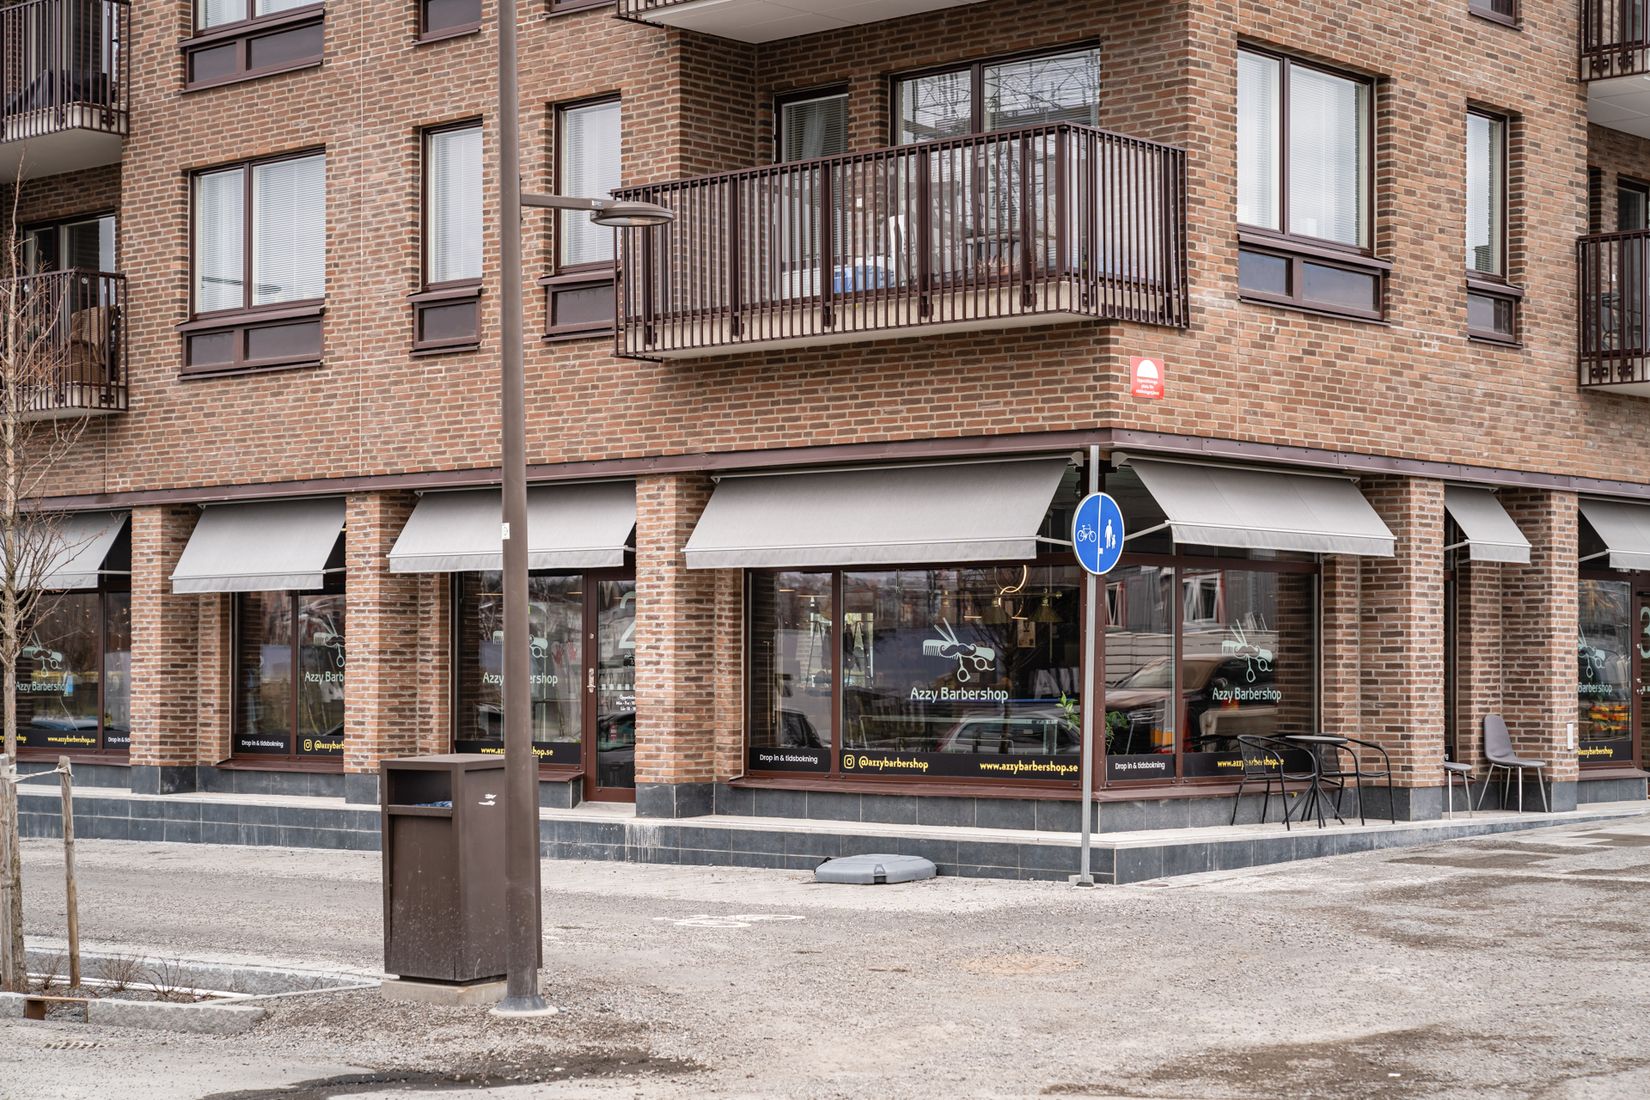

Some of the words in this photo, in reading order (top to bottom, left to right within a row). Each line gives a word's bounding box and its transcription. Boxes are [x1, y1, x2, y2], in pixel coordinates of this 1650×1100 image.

[304, 671, 324, 685] Azzy
[482, 672, 504, 687] Azzy
[910, 686, 938, 703] Azzy
[940, 687, 1009, 704] Barbershop
[1212, 687, 1233, 703] Azzy
[1234, 687, 1282, 703] Barbershop
[241, 739, 251, 748] Drop
[759, 753, 773, 763] Drop
[785, 754, 818, 764] tidsbokning
[858, 755, 929, 772] @azzybarbershop
[979, 760, 1079, 775] www.azzybarbershop.se
[1115, 762, 1127, 772] Drop
[1137, 761, 1166, 770] tidsbokning
